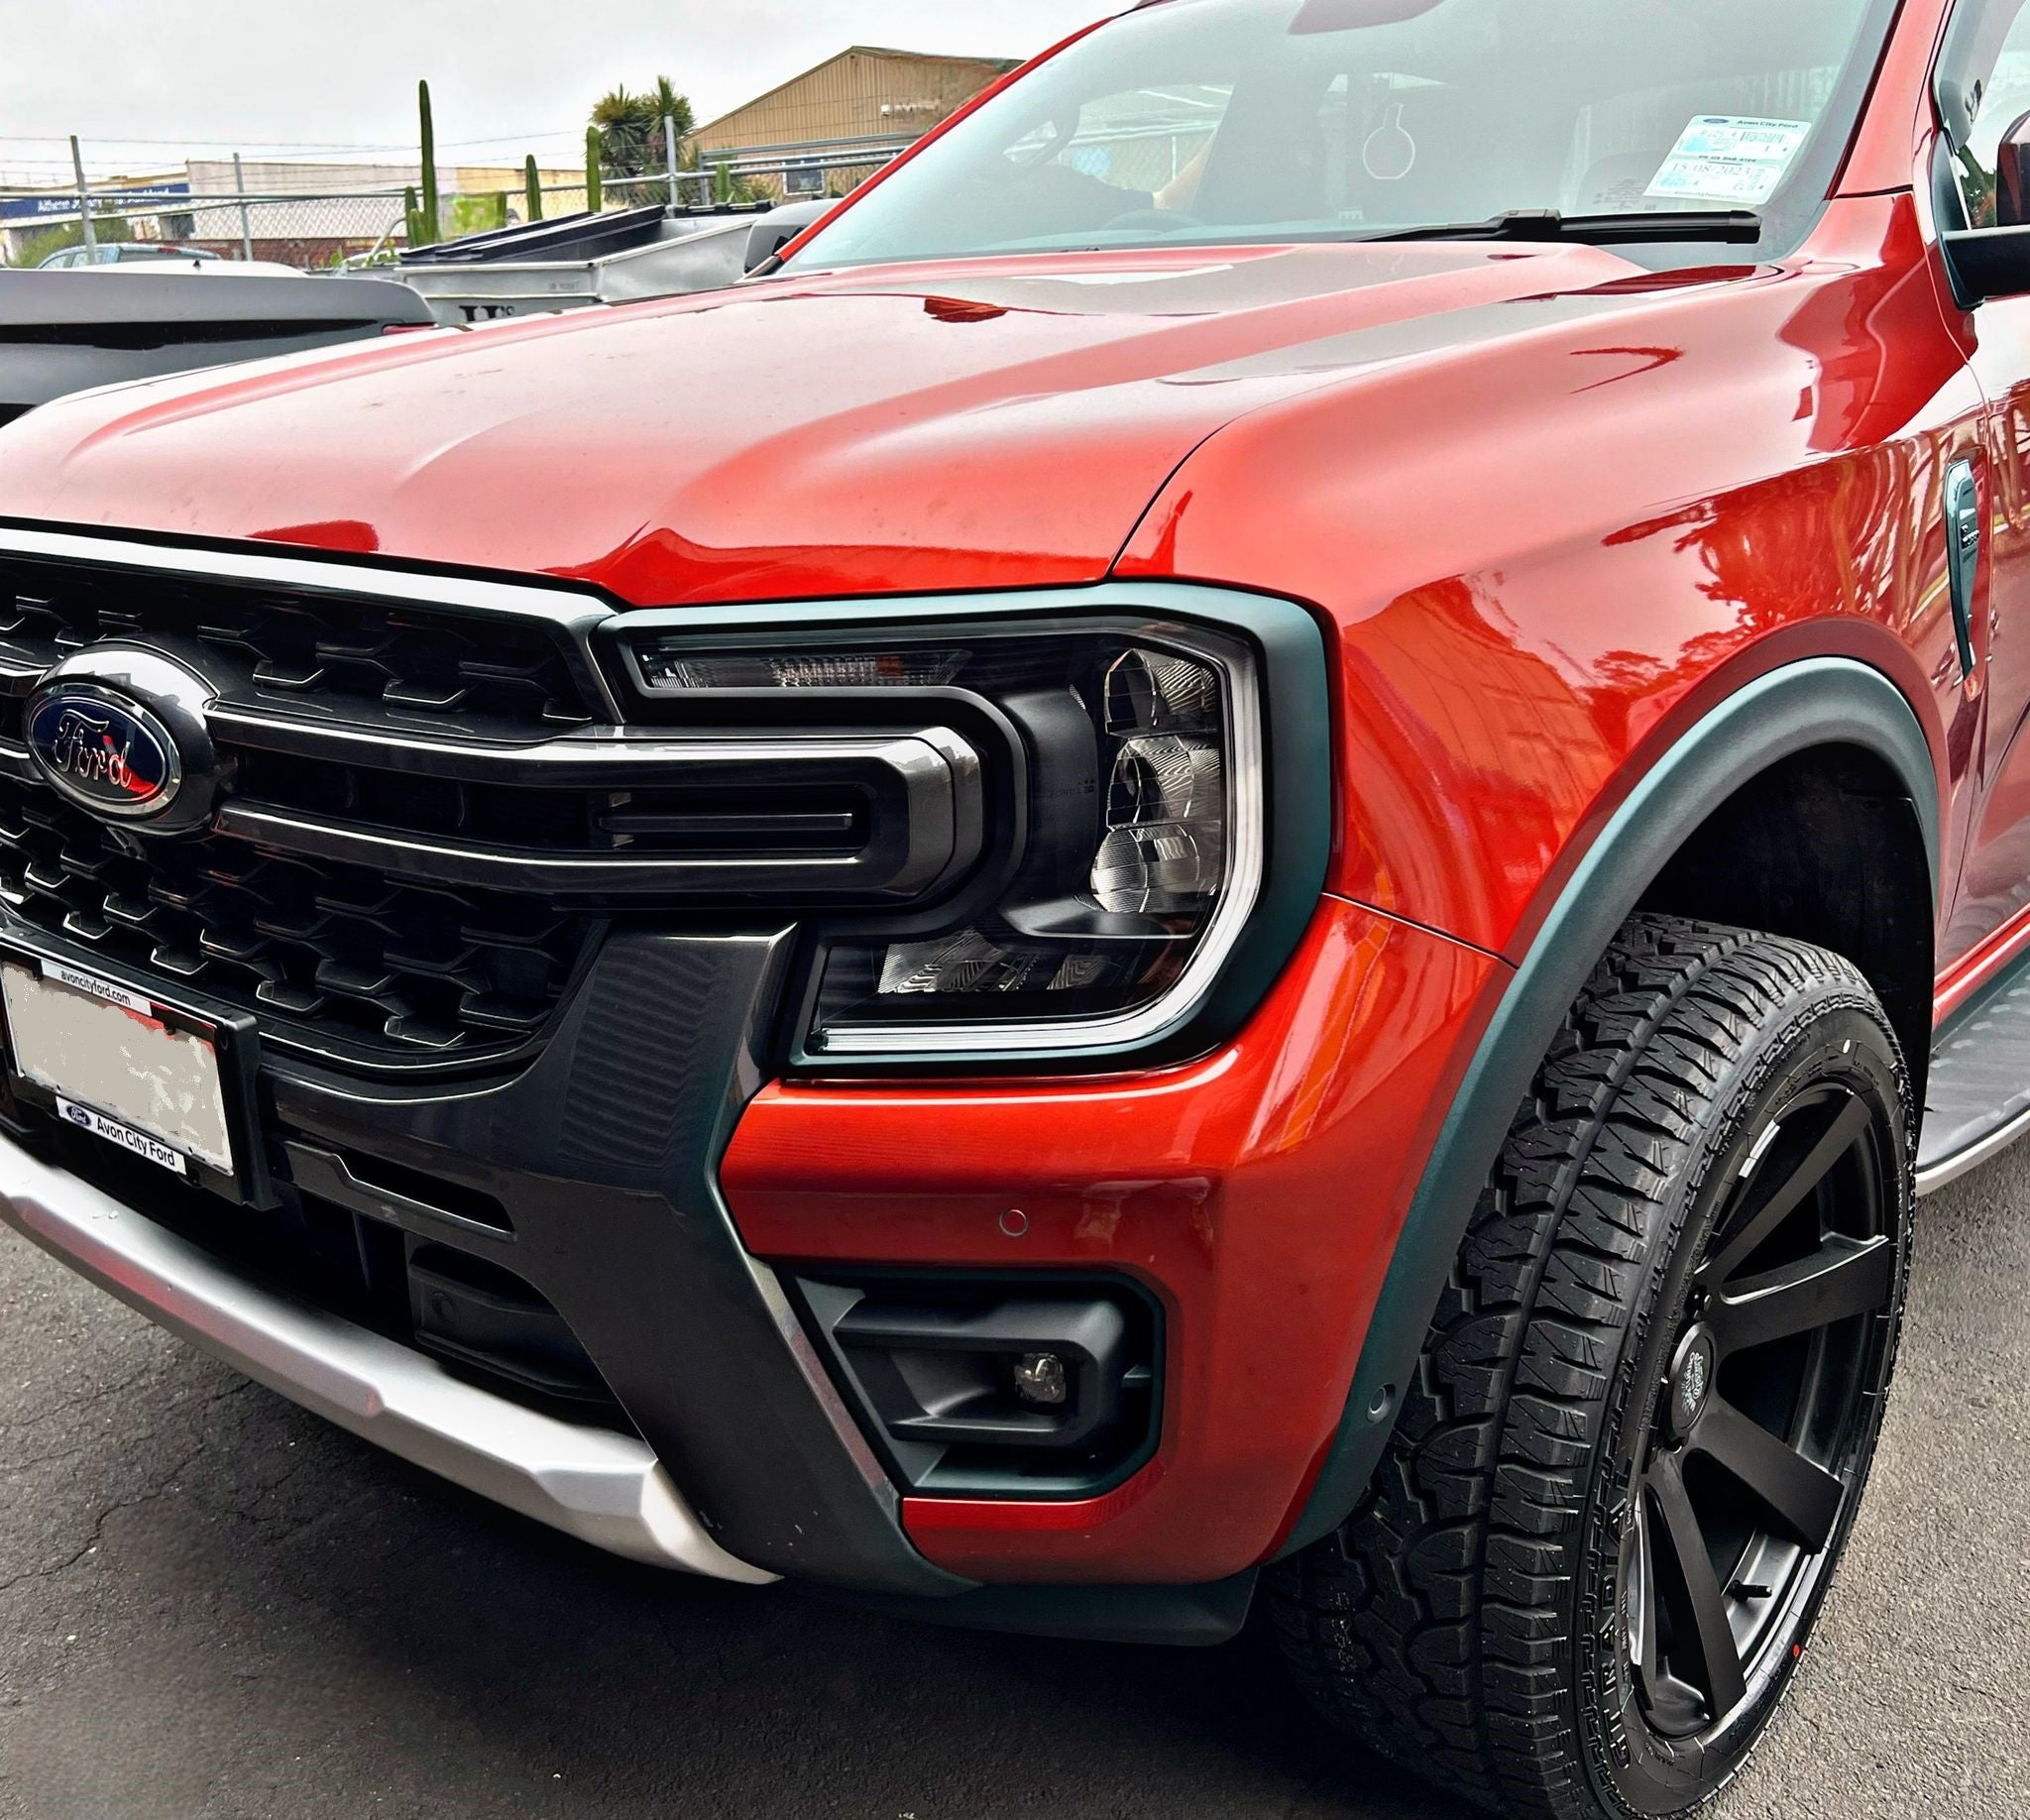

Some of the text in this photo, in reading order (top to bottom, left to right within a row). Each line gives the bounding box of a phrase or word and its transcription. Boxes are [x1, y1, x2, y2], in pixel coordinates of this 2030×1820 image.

[54, 709, 132, 787] Ford
[60, 969, 131, 1006] avoncityford.com
[97, 1116, 124, 1143] Avon
[125, 1130, 148, 1156] City
[149, 1141, 175, 1167] Ford
